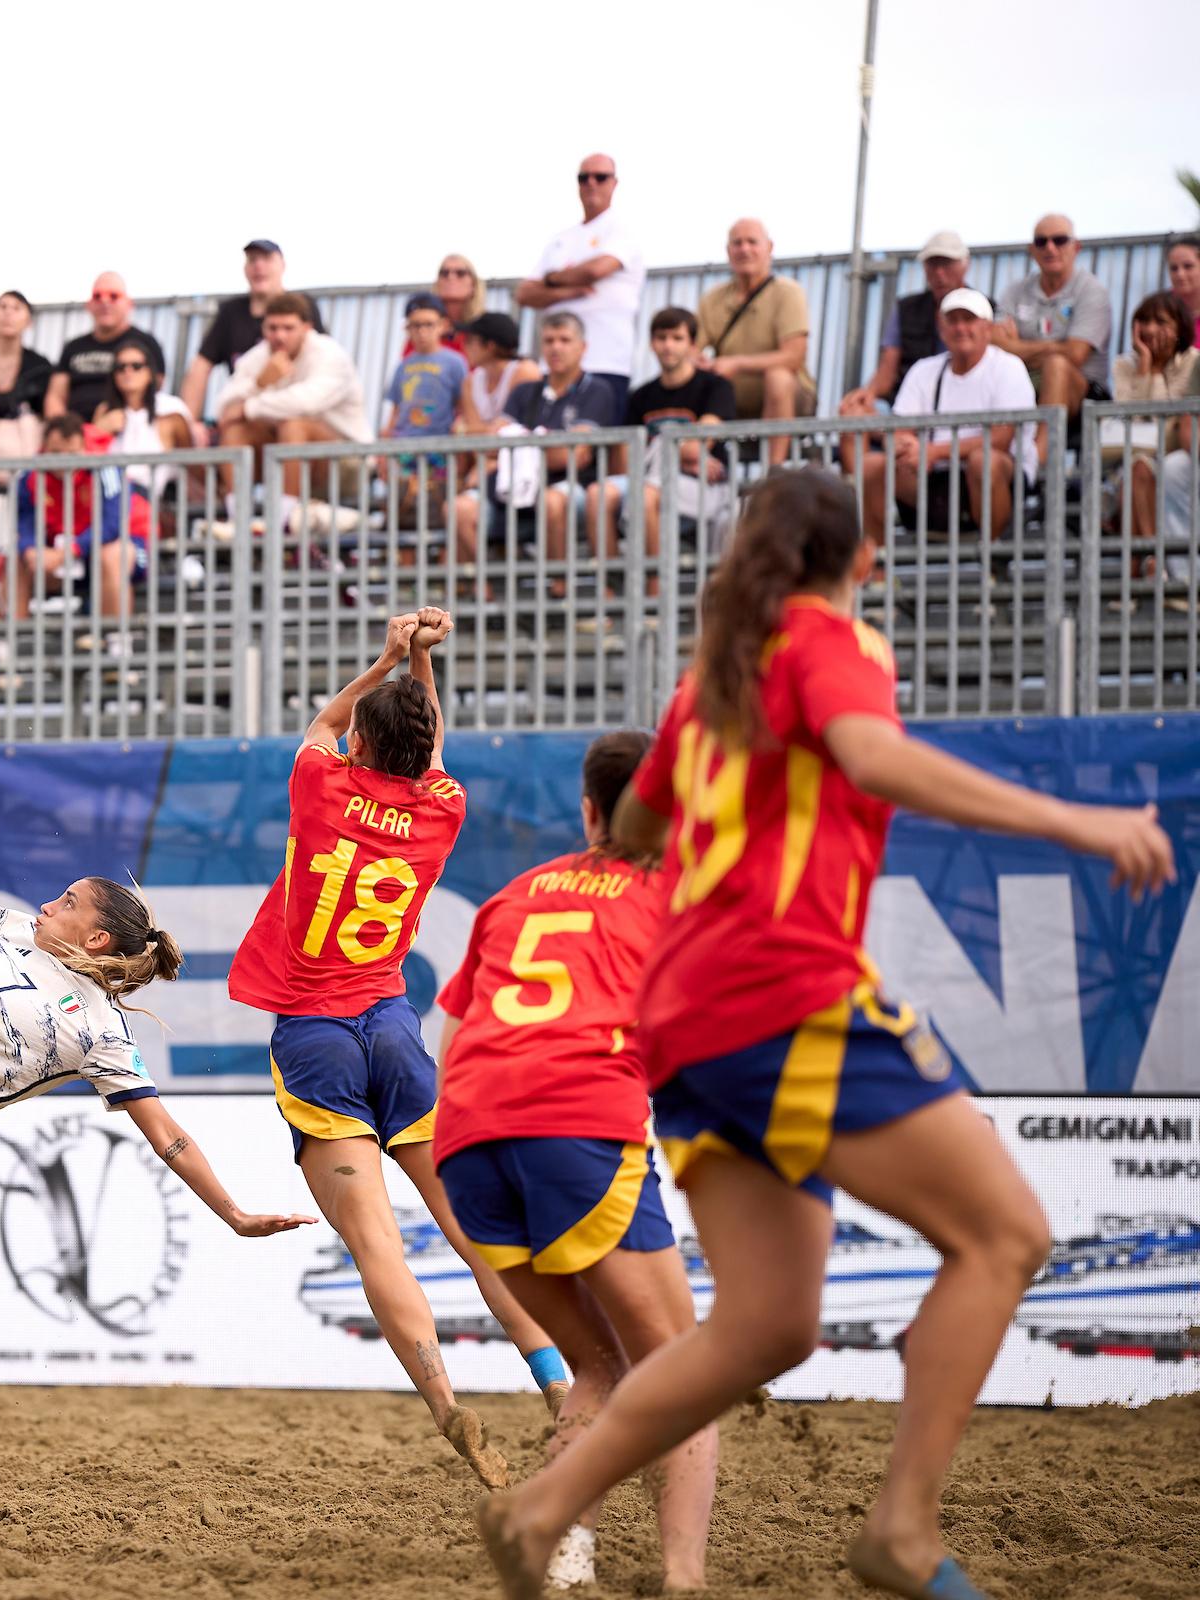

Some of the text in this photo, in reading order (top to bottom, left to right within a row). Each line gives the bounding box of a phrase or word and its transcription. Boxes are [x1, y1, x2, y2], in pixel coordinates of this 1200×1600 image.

[343, 796, 413, 838] PILAR
[303, 838, 419, 964] 18
[528, 870, 633, 899] MANAU
[491, 910, 594, 1026] 5
[1018, 1116, 1192, 1142] GEMIGNANI
